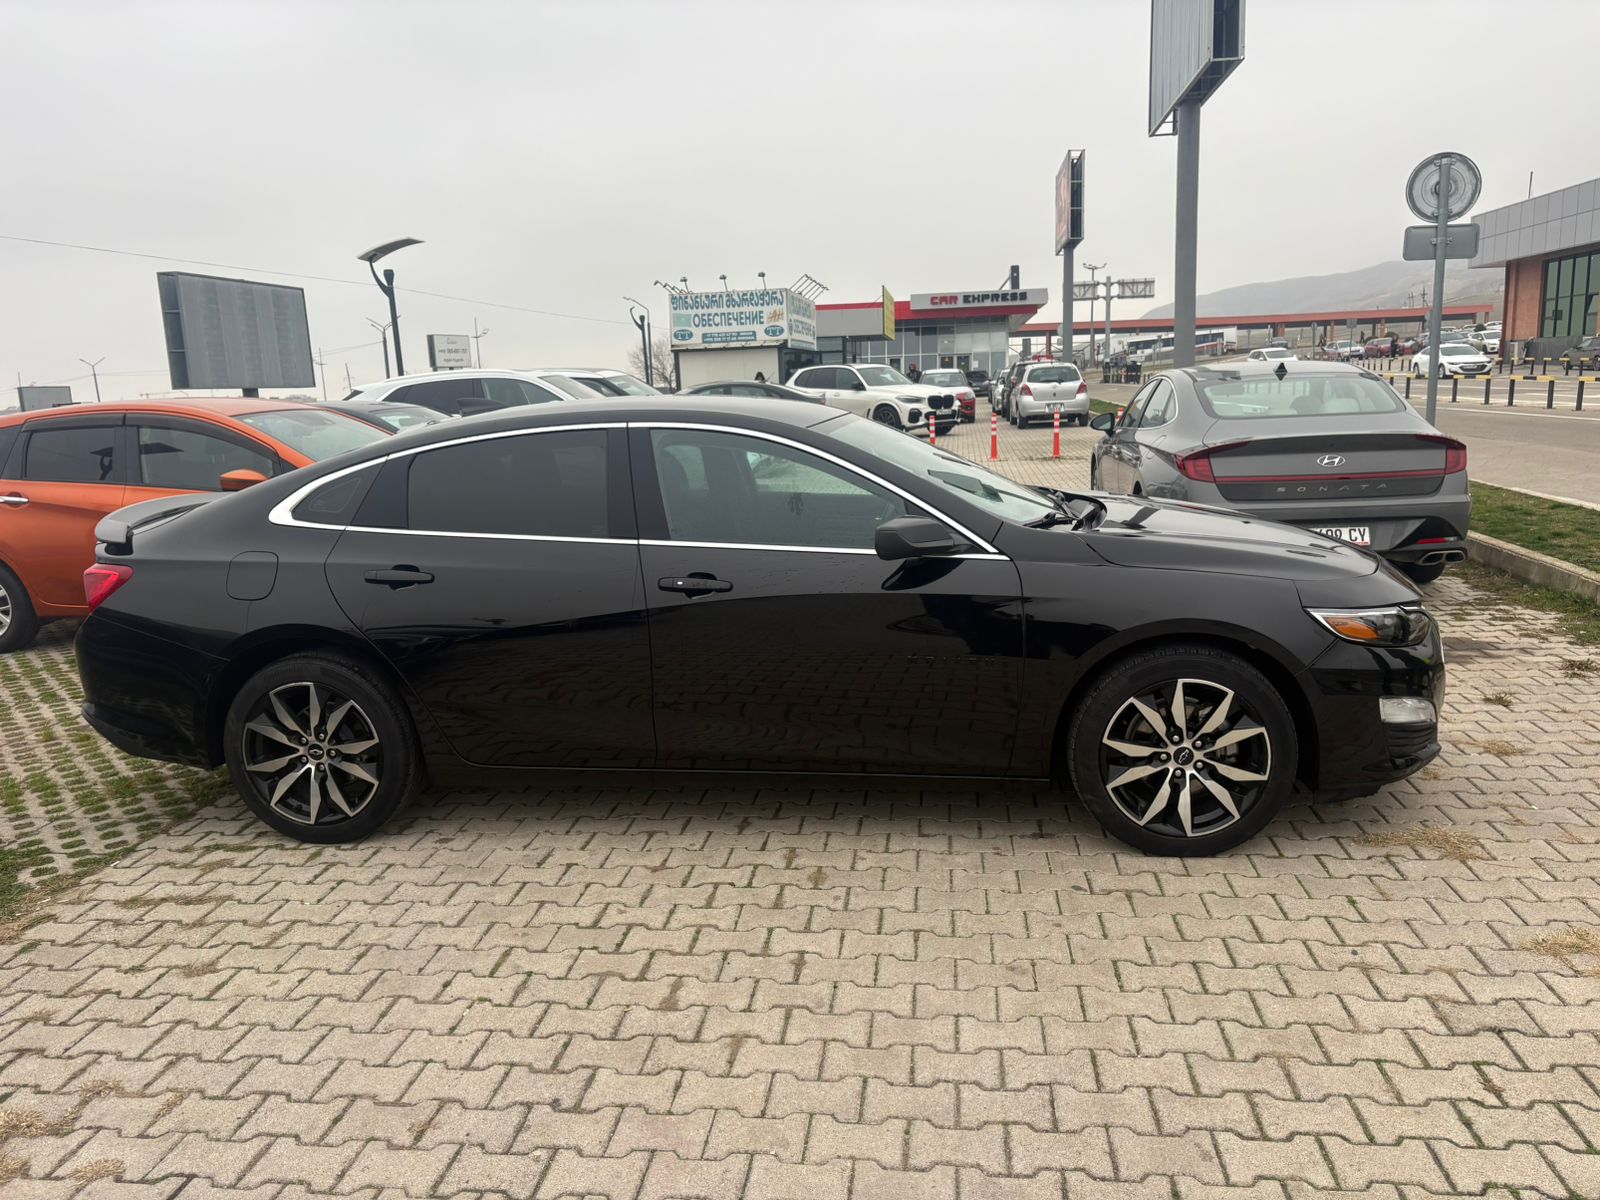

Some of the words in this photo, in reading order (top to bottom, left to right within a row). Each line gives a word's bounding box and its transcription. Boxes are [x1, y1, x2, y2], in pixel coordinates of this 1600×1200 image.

[930, 295, 959, 306] CAR
[693, 311, 764, 327] ОБЕСПЕЧЕНИЕ
[1276, 483, 1388, 493] SONATA
